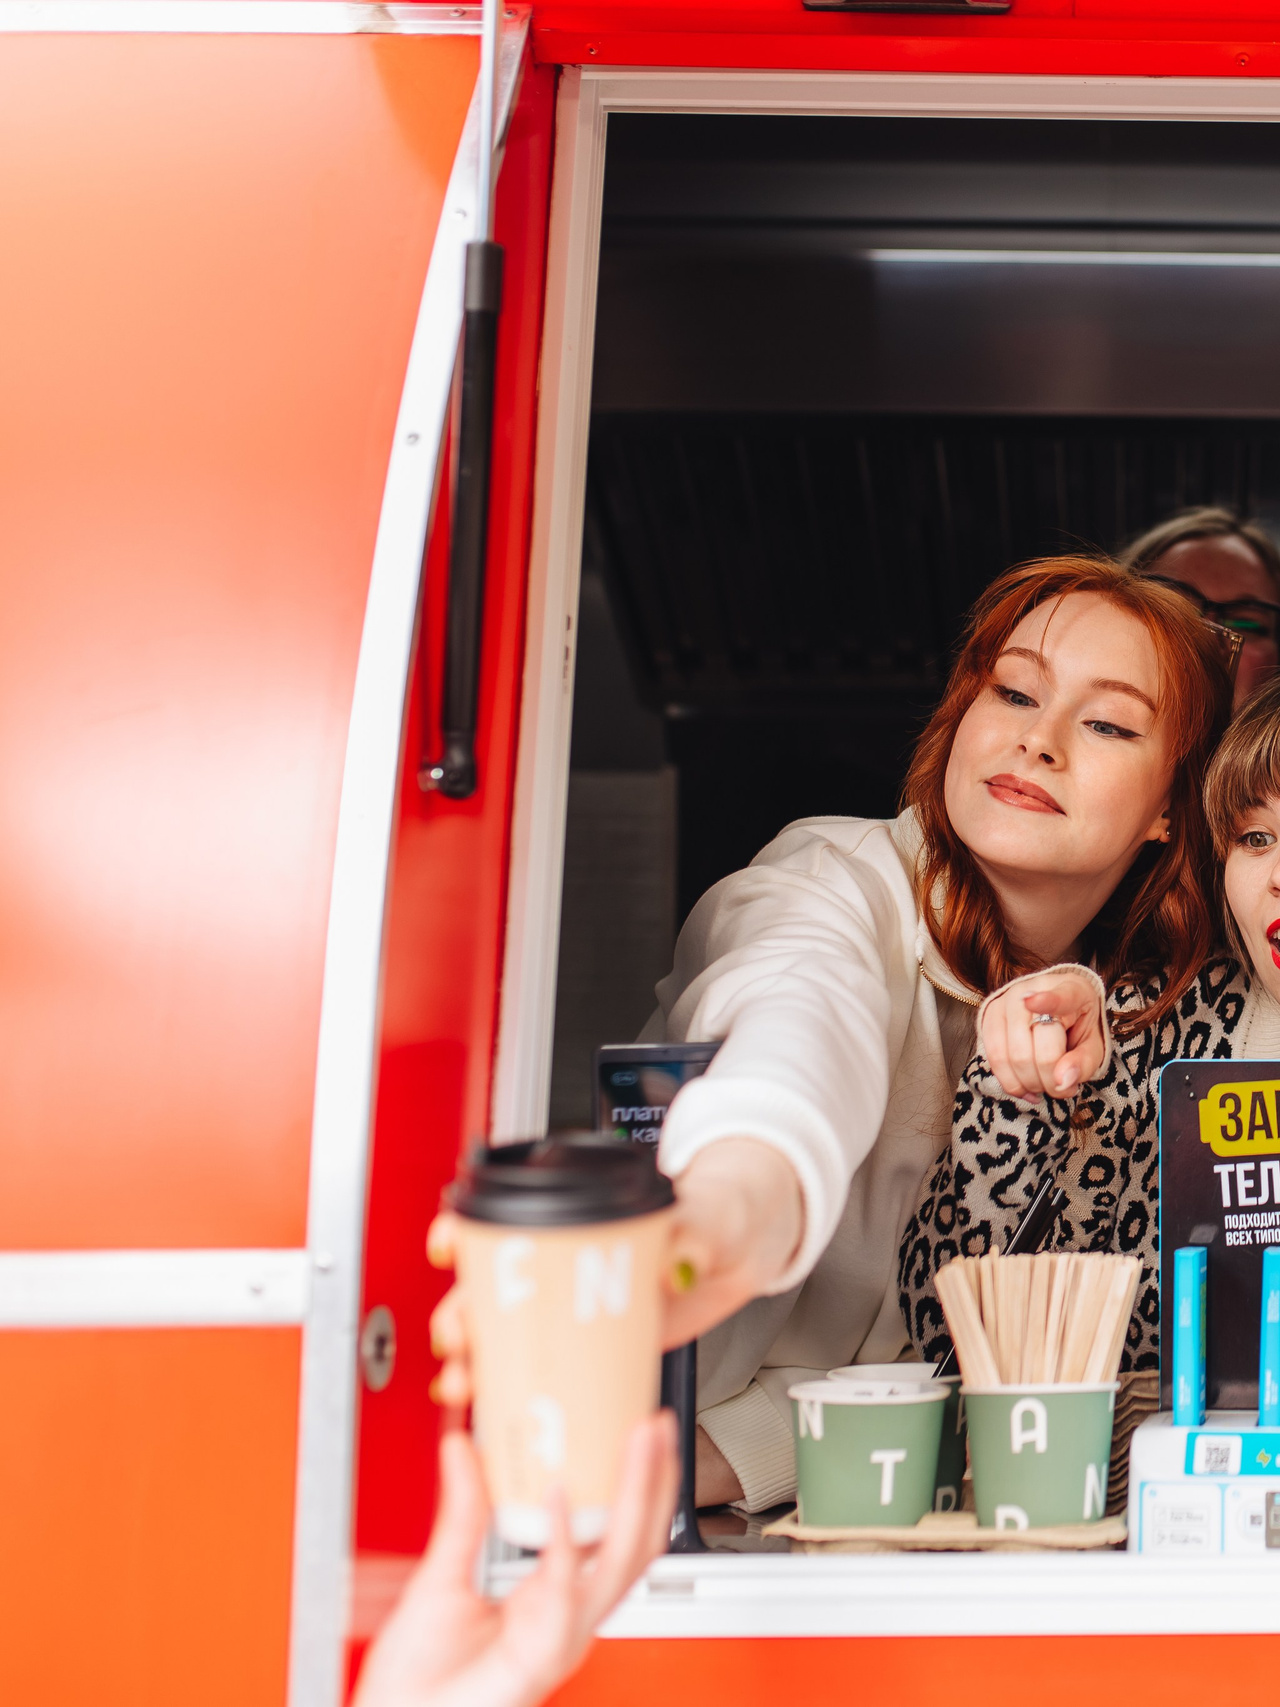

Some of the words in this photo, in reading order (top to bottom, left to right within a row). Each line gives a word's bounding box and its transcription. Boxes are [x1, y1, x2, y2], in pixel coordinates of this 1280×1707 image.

[1224, 1211, 1280, 1230] ПОДХОДИТ
[1226, 1230, 1253, 1246] ВСЕХ
[1010, 1397, 1048, 1454] A
[870, 1449, 908, 1506] T
